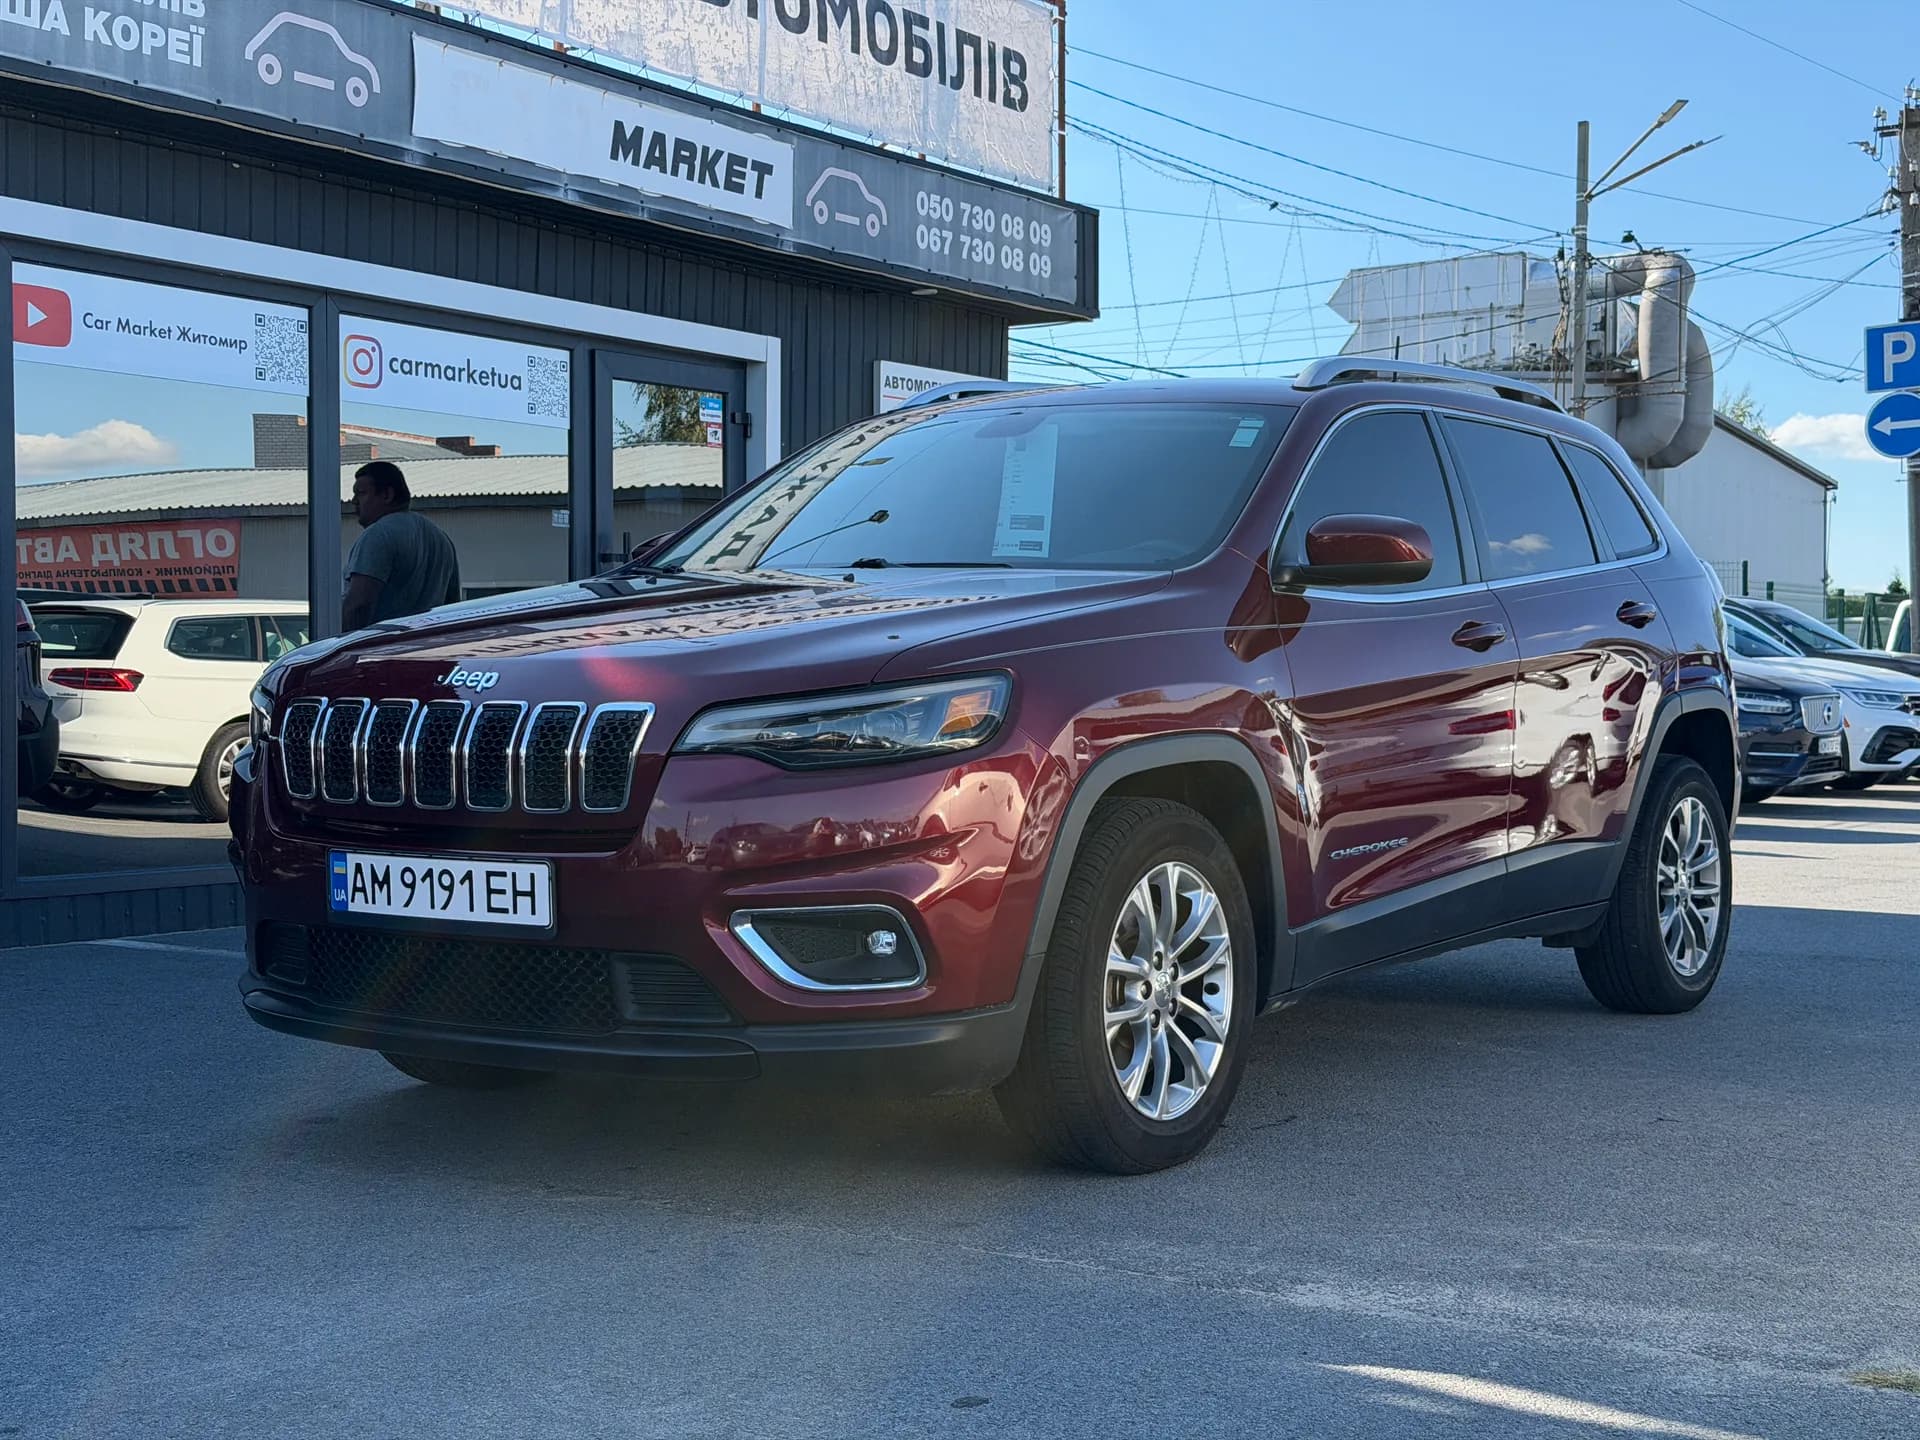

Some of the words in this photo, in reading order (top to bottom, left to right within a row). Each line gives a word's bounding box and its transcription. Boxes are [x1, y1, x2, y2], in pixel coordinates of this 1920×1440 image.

[84, 6, 206, 67] КОРЕЇ
[609, 119, 774, 200] MARKET
[916, 190, 954, 222] 050
[960, 202, 995, 232] 730
[1001, 213, 1024, 240] 08
[1029, 220, 1052, 247] 09
[916, 224, 953, 255] 067
[960, 235, 995, 265] 730
[1001, 245, 1024, 272] 08
[1029, 252, 1052, 278] 09
[82, 312, 112, 331] Car
[116, 317, 172, 340] Market
[176, 325, 248, 354] Житомир
[1883, 331, 1916, 383] P
[388, 357, 522, 391] carmarketua
[437, 665, 499, 693] Jeep
[1330, 837, 1409, 860] CHEROKEE
[334, 888, 347, 902] UA
[350, 862, 392, 906] AM
[401, 866, 475, 912] 9191
[485, 870, 536, 916] EH
